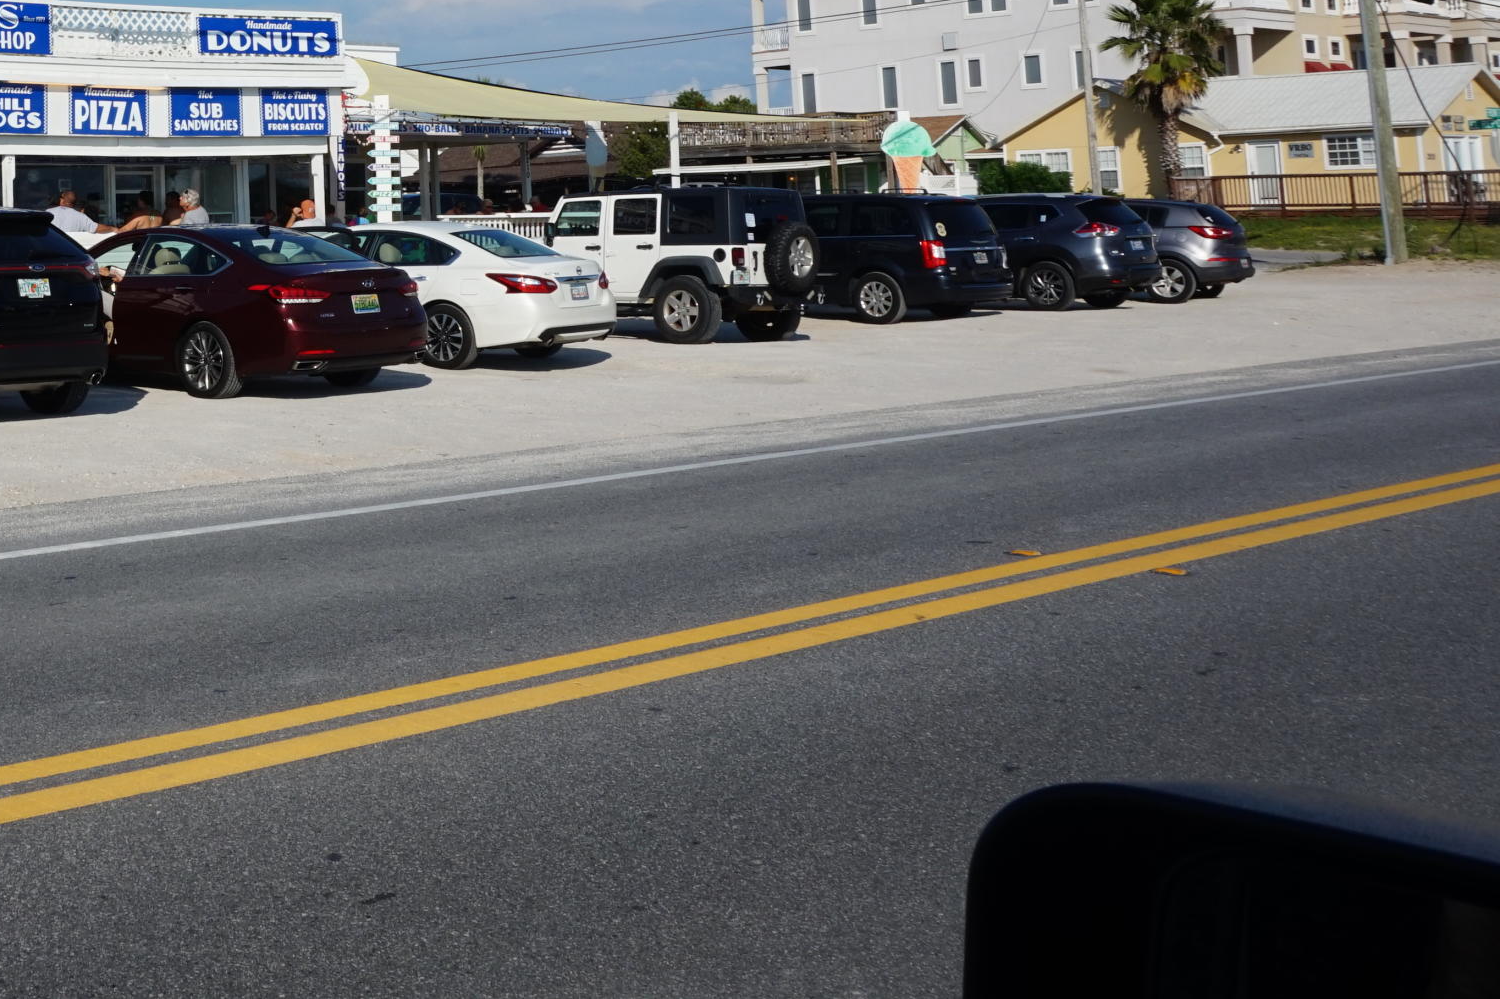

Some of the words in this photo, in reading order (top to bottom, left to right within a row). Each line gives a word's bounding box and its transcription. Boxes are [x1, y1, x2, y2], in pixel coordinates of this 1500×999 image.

[245, 20, 293, 30] Handmade
[206, 30, 331, 53] DONUTS
[84, 87, 135, 98] Handmade
[197, 90, 213, 99] Hot
[272, 91, 286, 100] Hot
[293, 91, 317, 102] Flaky
[74, 99, 144, 132] PIZZA
[189, 102, 223, 119] SUB
[264, 103, 326, 121] BISCUITS
[174, 119, 239, 132] SANDWICHES
[268, 123, 289, 131] FROM
[291, 123, 324, 131] SCRATCH
[465, 125, 501, 135] BANANA
